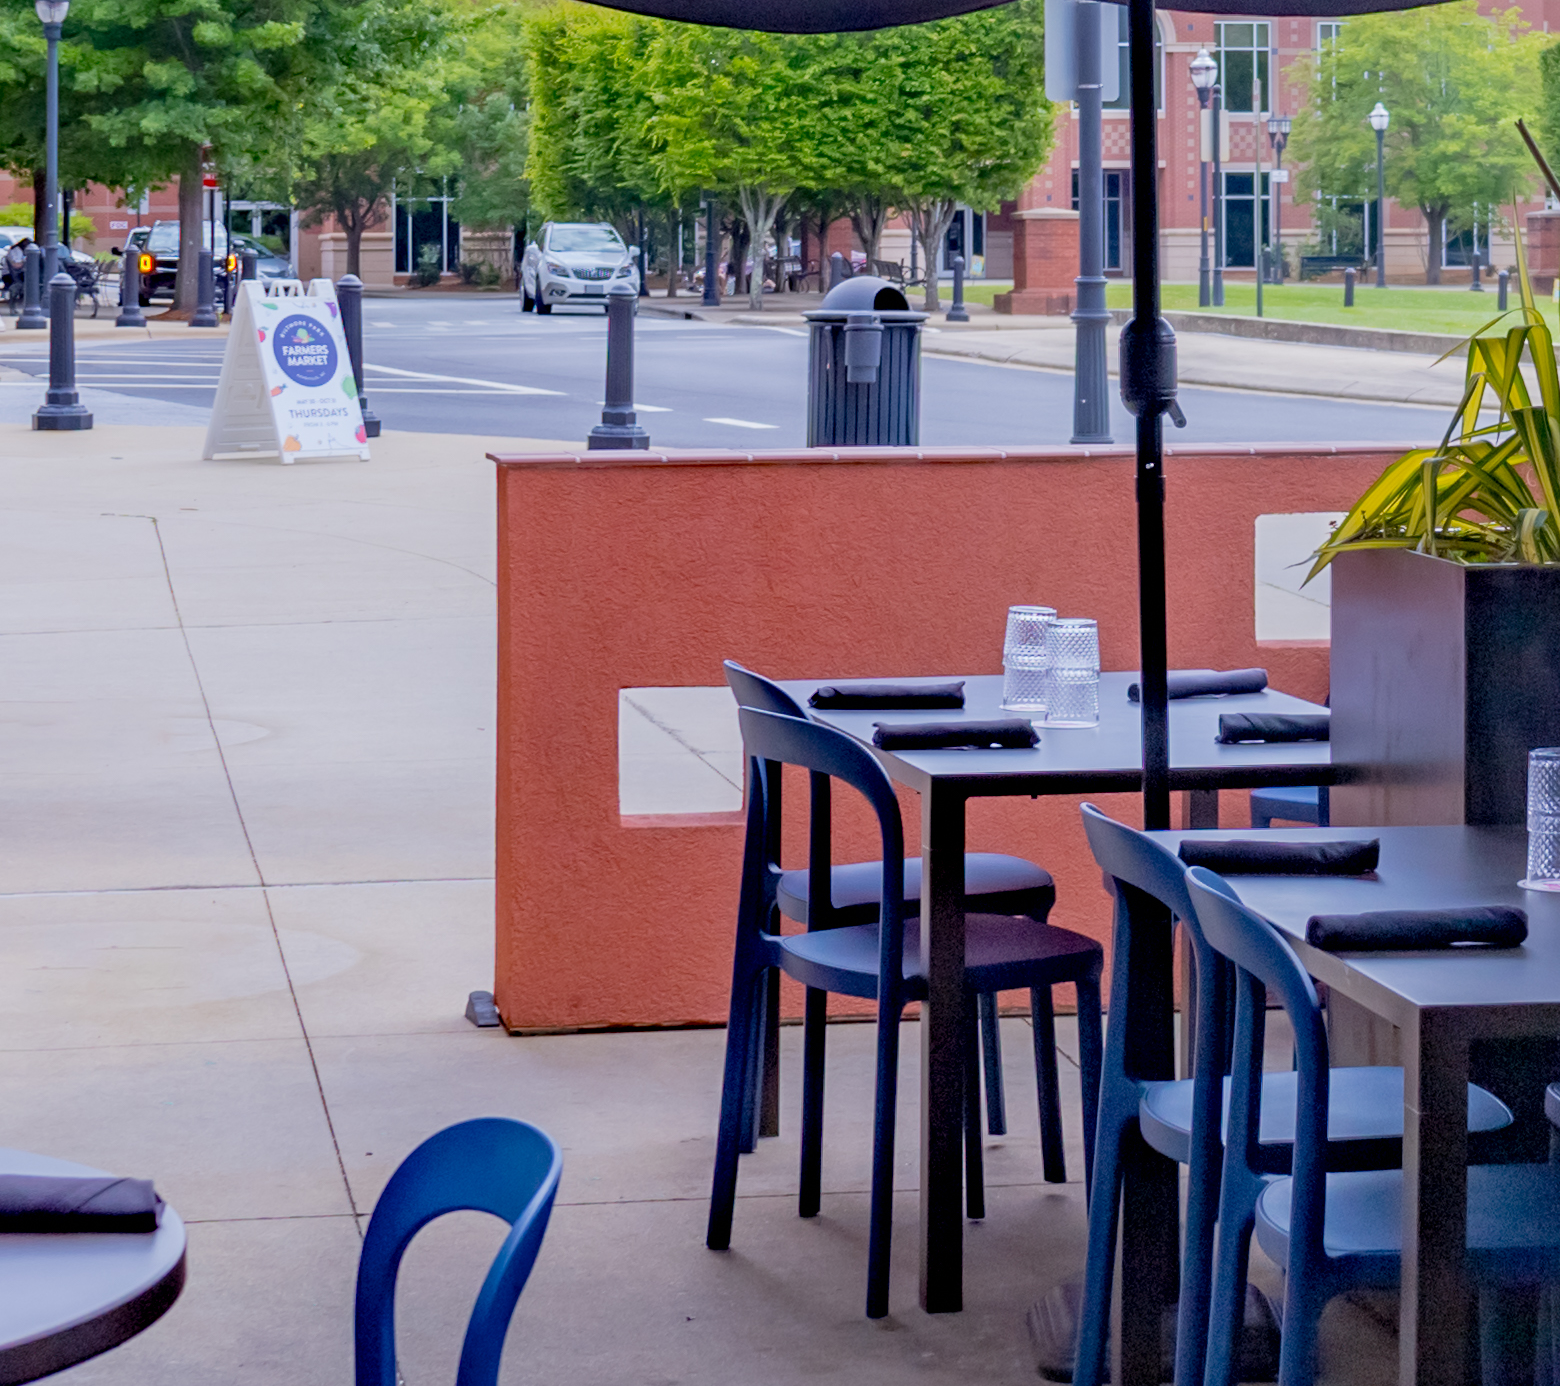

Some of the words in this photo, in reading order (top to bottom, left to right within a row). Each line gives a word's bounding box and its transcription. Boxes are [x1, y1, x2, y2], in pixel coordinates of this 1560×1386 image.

[282, 345, 329, 356] FARMERS
[287, 356, 328, 366] MARKET
[288, 407, 348, 418] THURSDAYS
